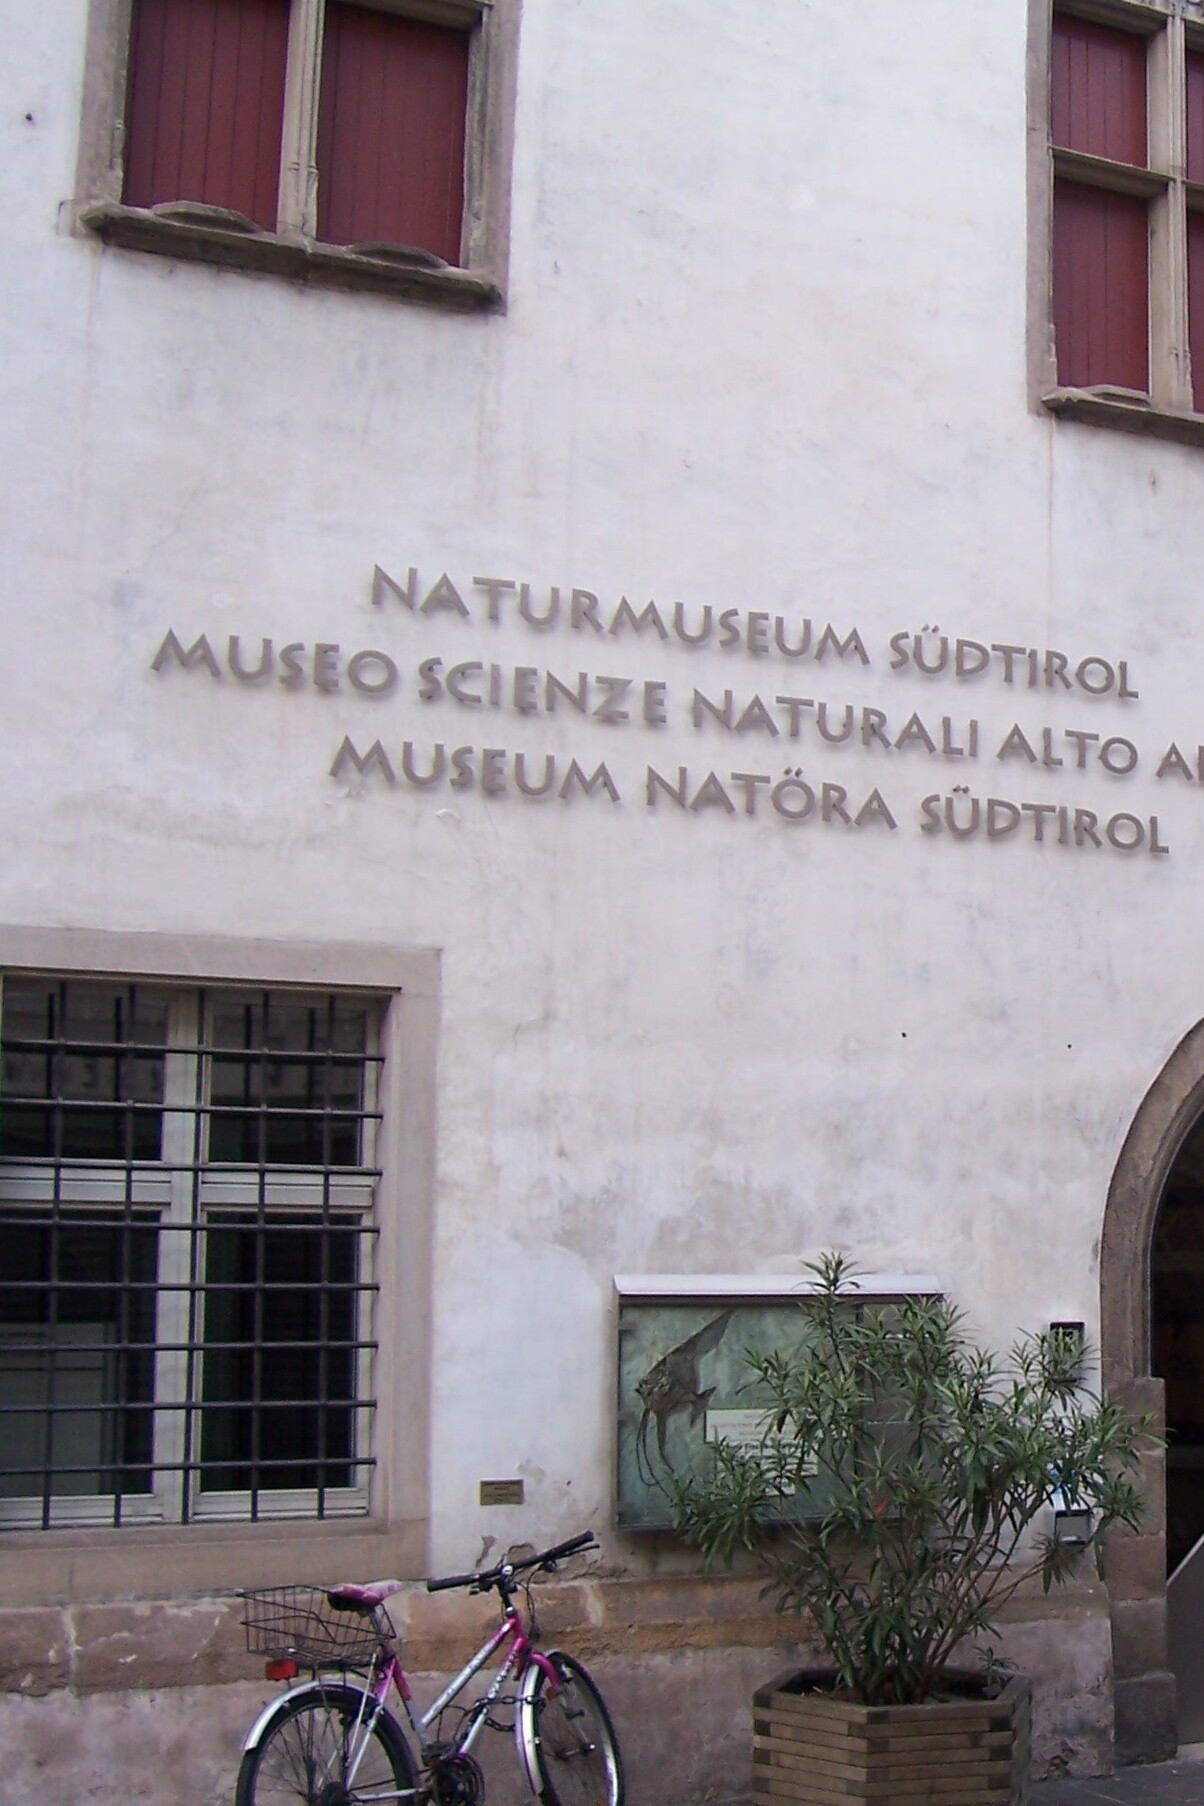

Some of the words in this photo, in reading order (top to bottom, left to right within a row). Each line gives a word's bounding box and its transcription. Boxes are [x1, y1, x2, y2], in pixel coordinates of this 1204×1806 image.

[371, 563, 871, 666] NATURMUSEUM
[888, 625, 1139, 701] SÜDTIROL
[151, 628, 399, 694] MUSEO
[417, 656, 669, 725] SCIENZE
[692, 687, 979, 759] NATURALI
[996, 722, 1140, 775] ALTO
[328, 735, 622, 803] MUSEUM
[646, 764, 898, 831] NATÖRA
[920, 785, 1170, 855] SÜDTIROL
